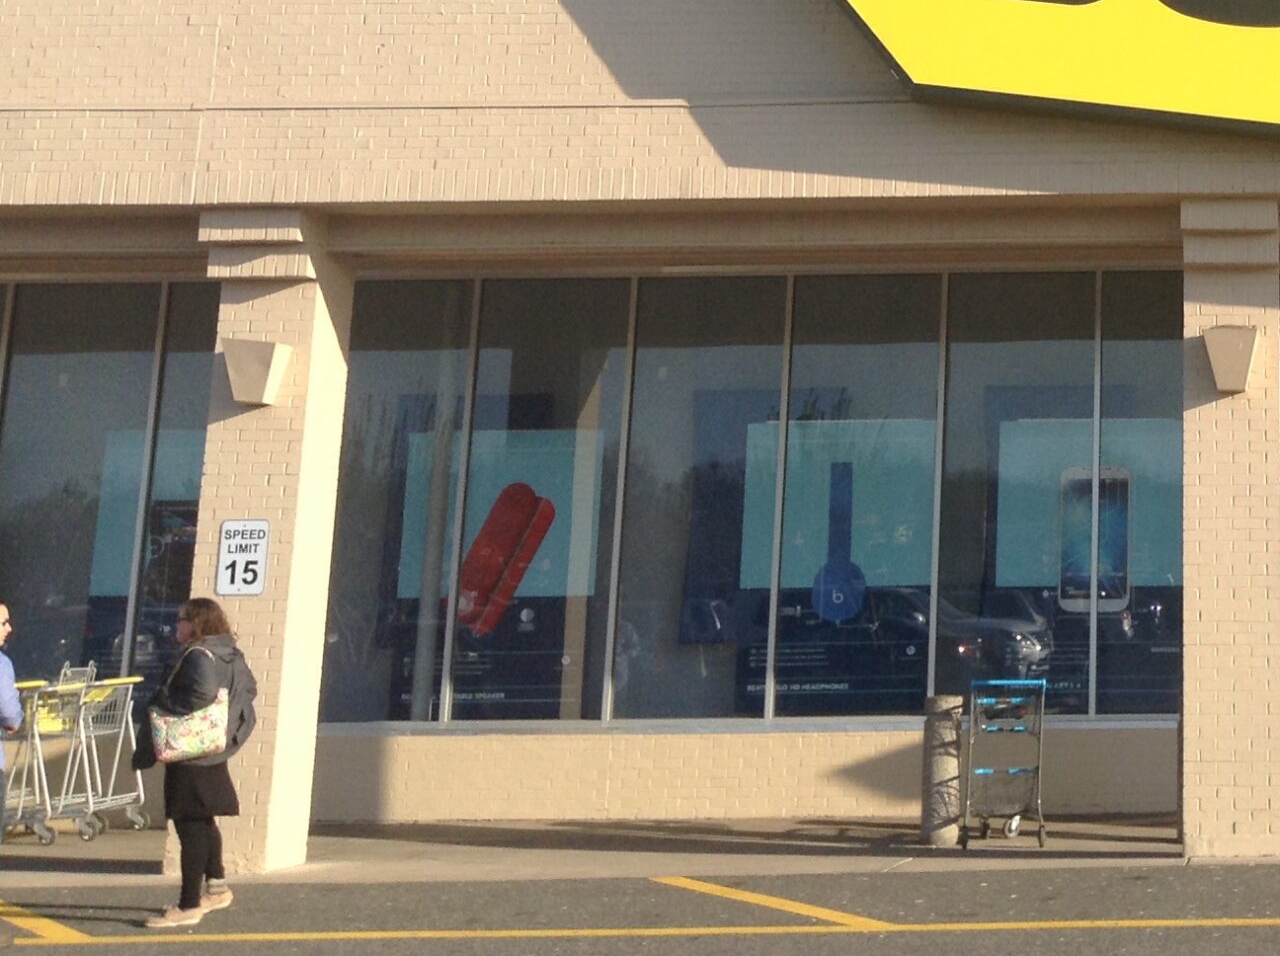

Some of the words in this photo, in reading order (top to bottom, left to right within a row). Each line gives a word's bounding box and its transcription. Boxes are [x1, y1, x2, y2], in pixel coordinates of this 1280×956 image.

[224, 529, 266, 540] SPEED
[227, 543, 260, 554] LIMIT
[225, 560, 259, 585] 15
